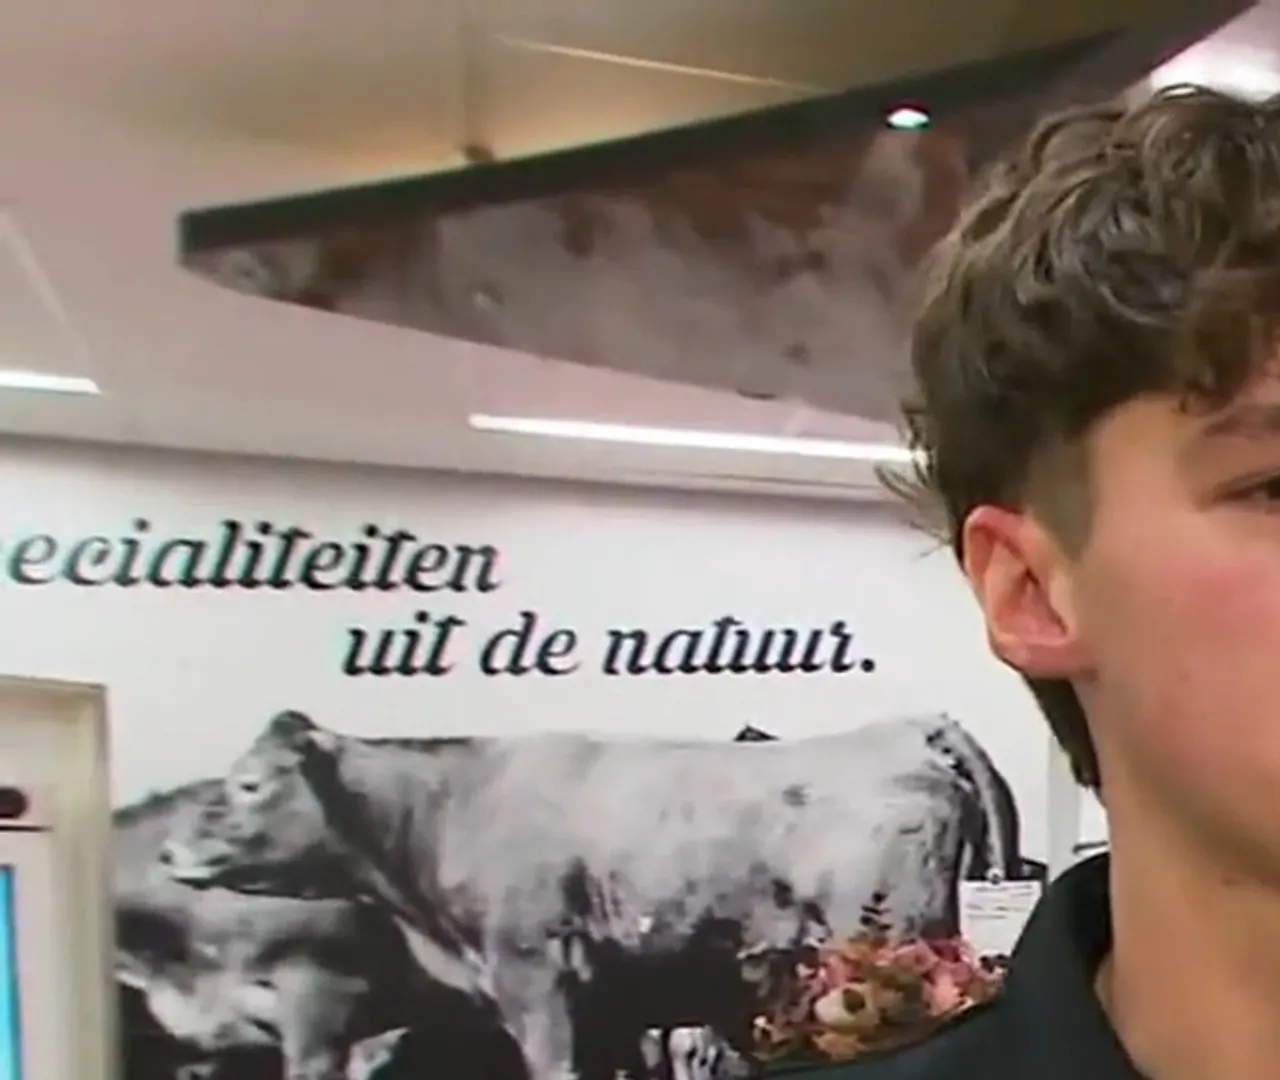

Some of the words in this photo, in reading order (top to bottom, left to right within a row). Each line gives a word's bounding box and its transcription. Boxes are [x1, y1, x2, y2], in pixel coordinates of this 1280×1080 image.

[342, 610, 466, 677] uit
[479, 610, 578, 677] de
[602, 615, 877, 677] natuur.
